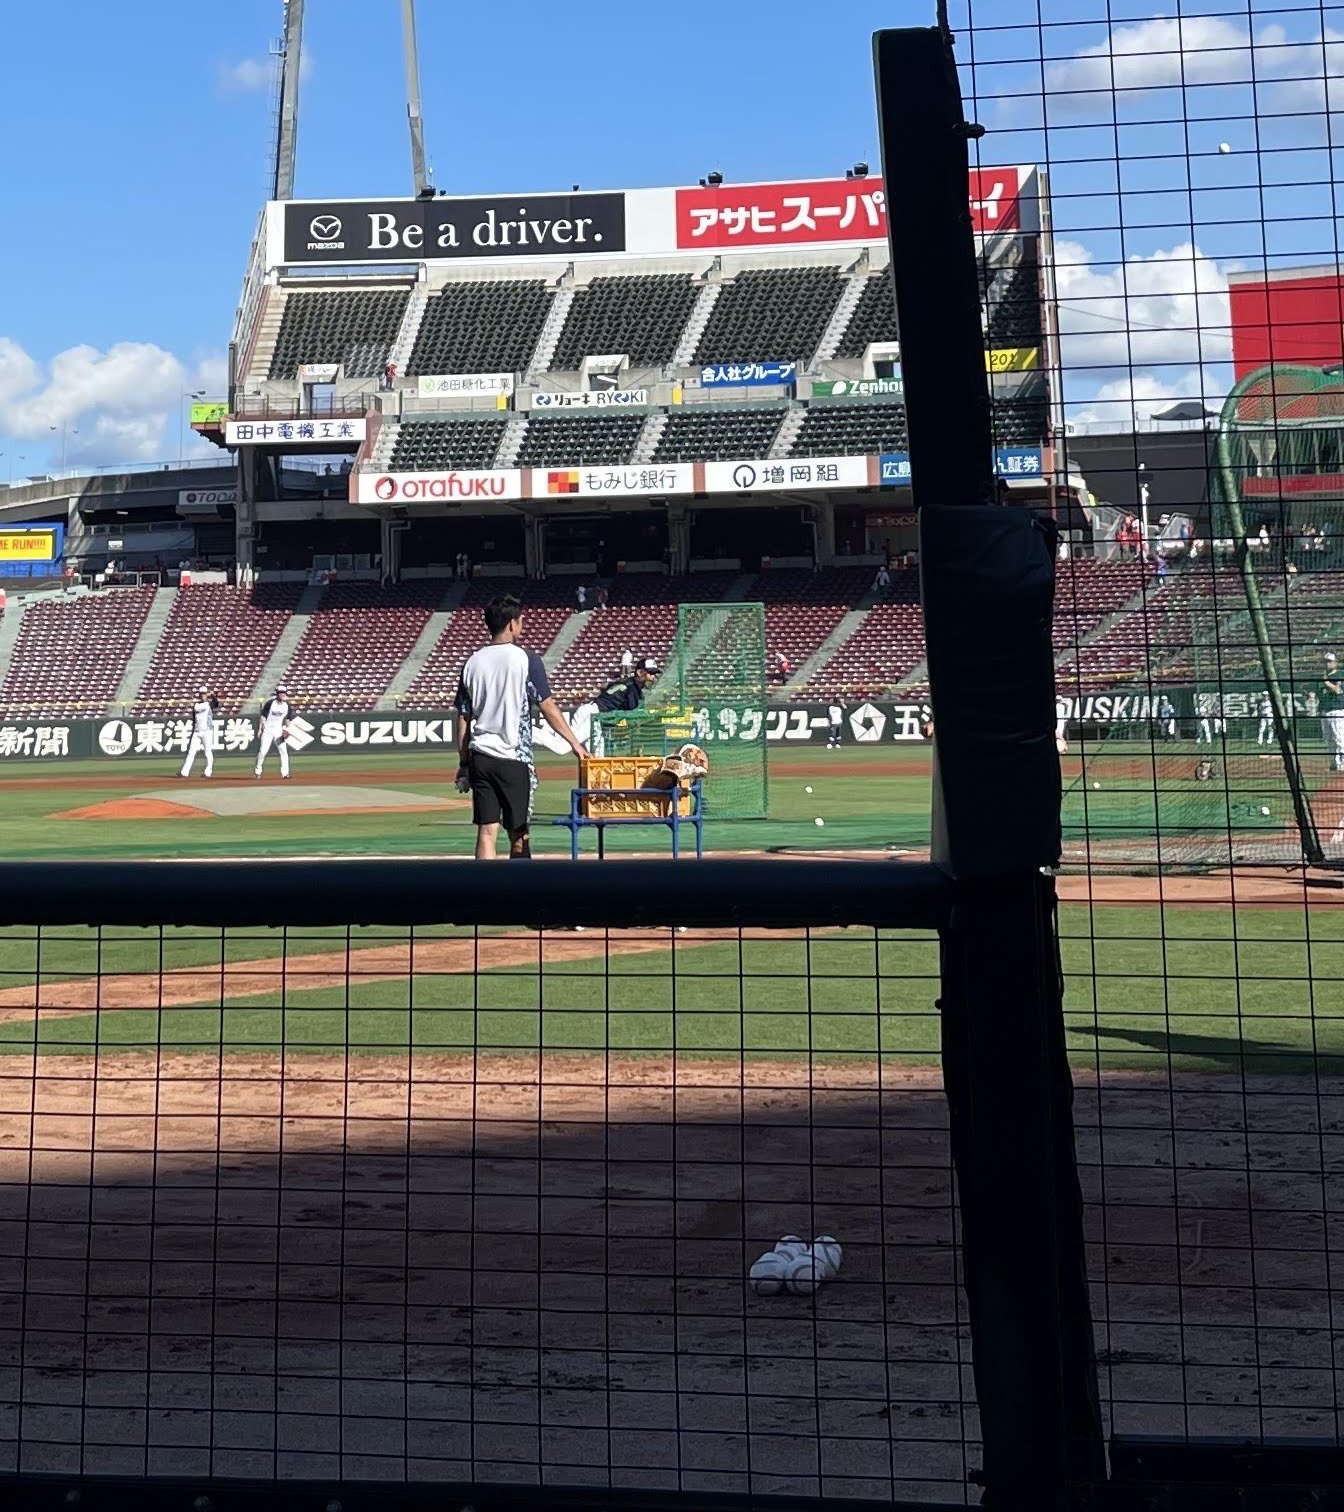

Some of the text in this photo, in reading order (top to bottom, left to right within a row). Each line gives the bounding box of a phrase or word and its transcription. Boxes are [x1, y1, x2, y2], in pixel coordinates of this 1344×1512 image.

[367, 209, 603, 250] Be a driver.
[701, 363, 796, 382] 合人社グループ
[236, 421, 355, 440] 田中電機工業
[586, 469, 677, 492] もみじ銀行
[762, 464, 840, 484] 増岡組
[320, 720, 452, 744] SUZUKI
[893, 705, 933, 740] 五
[134, 718, 254, 753] 東洋券
